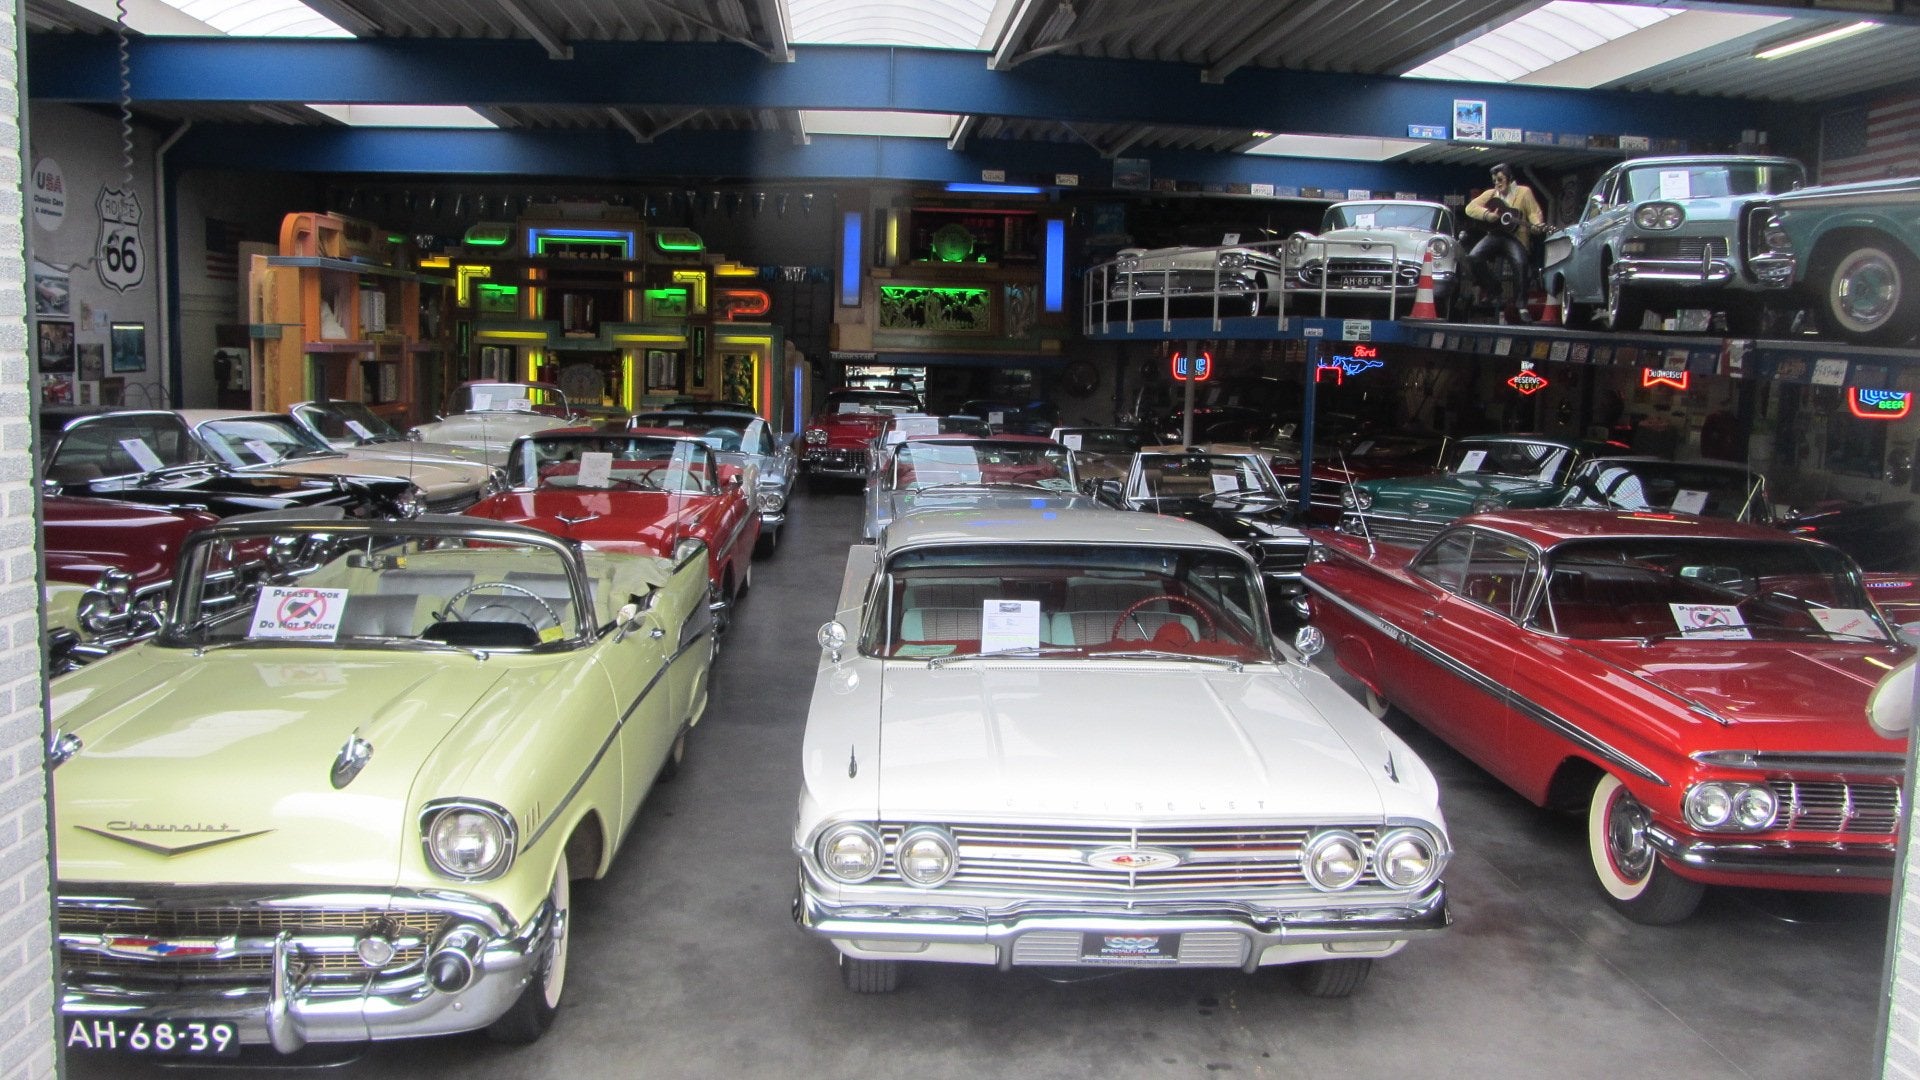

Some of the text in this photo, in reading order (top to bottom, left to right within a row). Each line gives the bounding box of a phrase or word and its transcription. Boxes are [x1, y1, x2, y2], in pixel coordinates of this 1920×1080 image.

[37, 171, 62, 193] USA
[107, 235, 136, 273] 66
[1354, 345, 1376, 357] Ford
[1514, 376, 1540, 384] RESERVE
[1879, 400, 1905, 410] BEER
[106, 820, 240, 832] Chevrolet
[67, 1020, 232, 1052] AH-68-39
